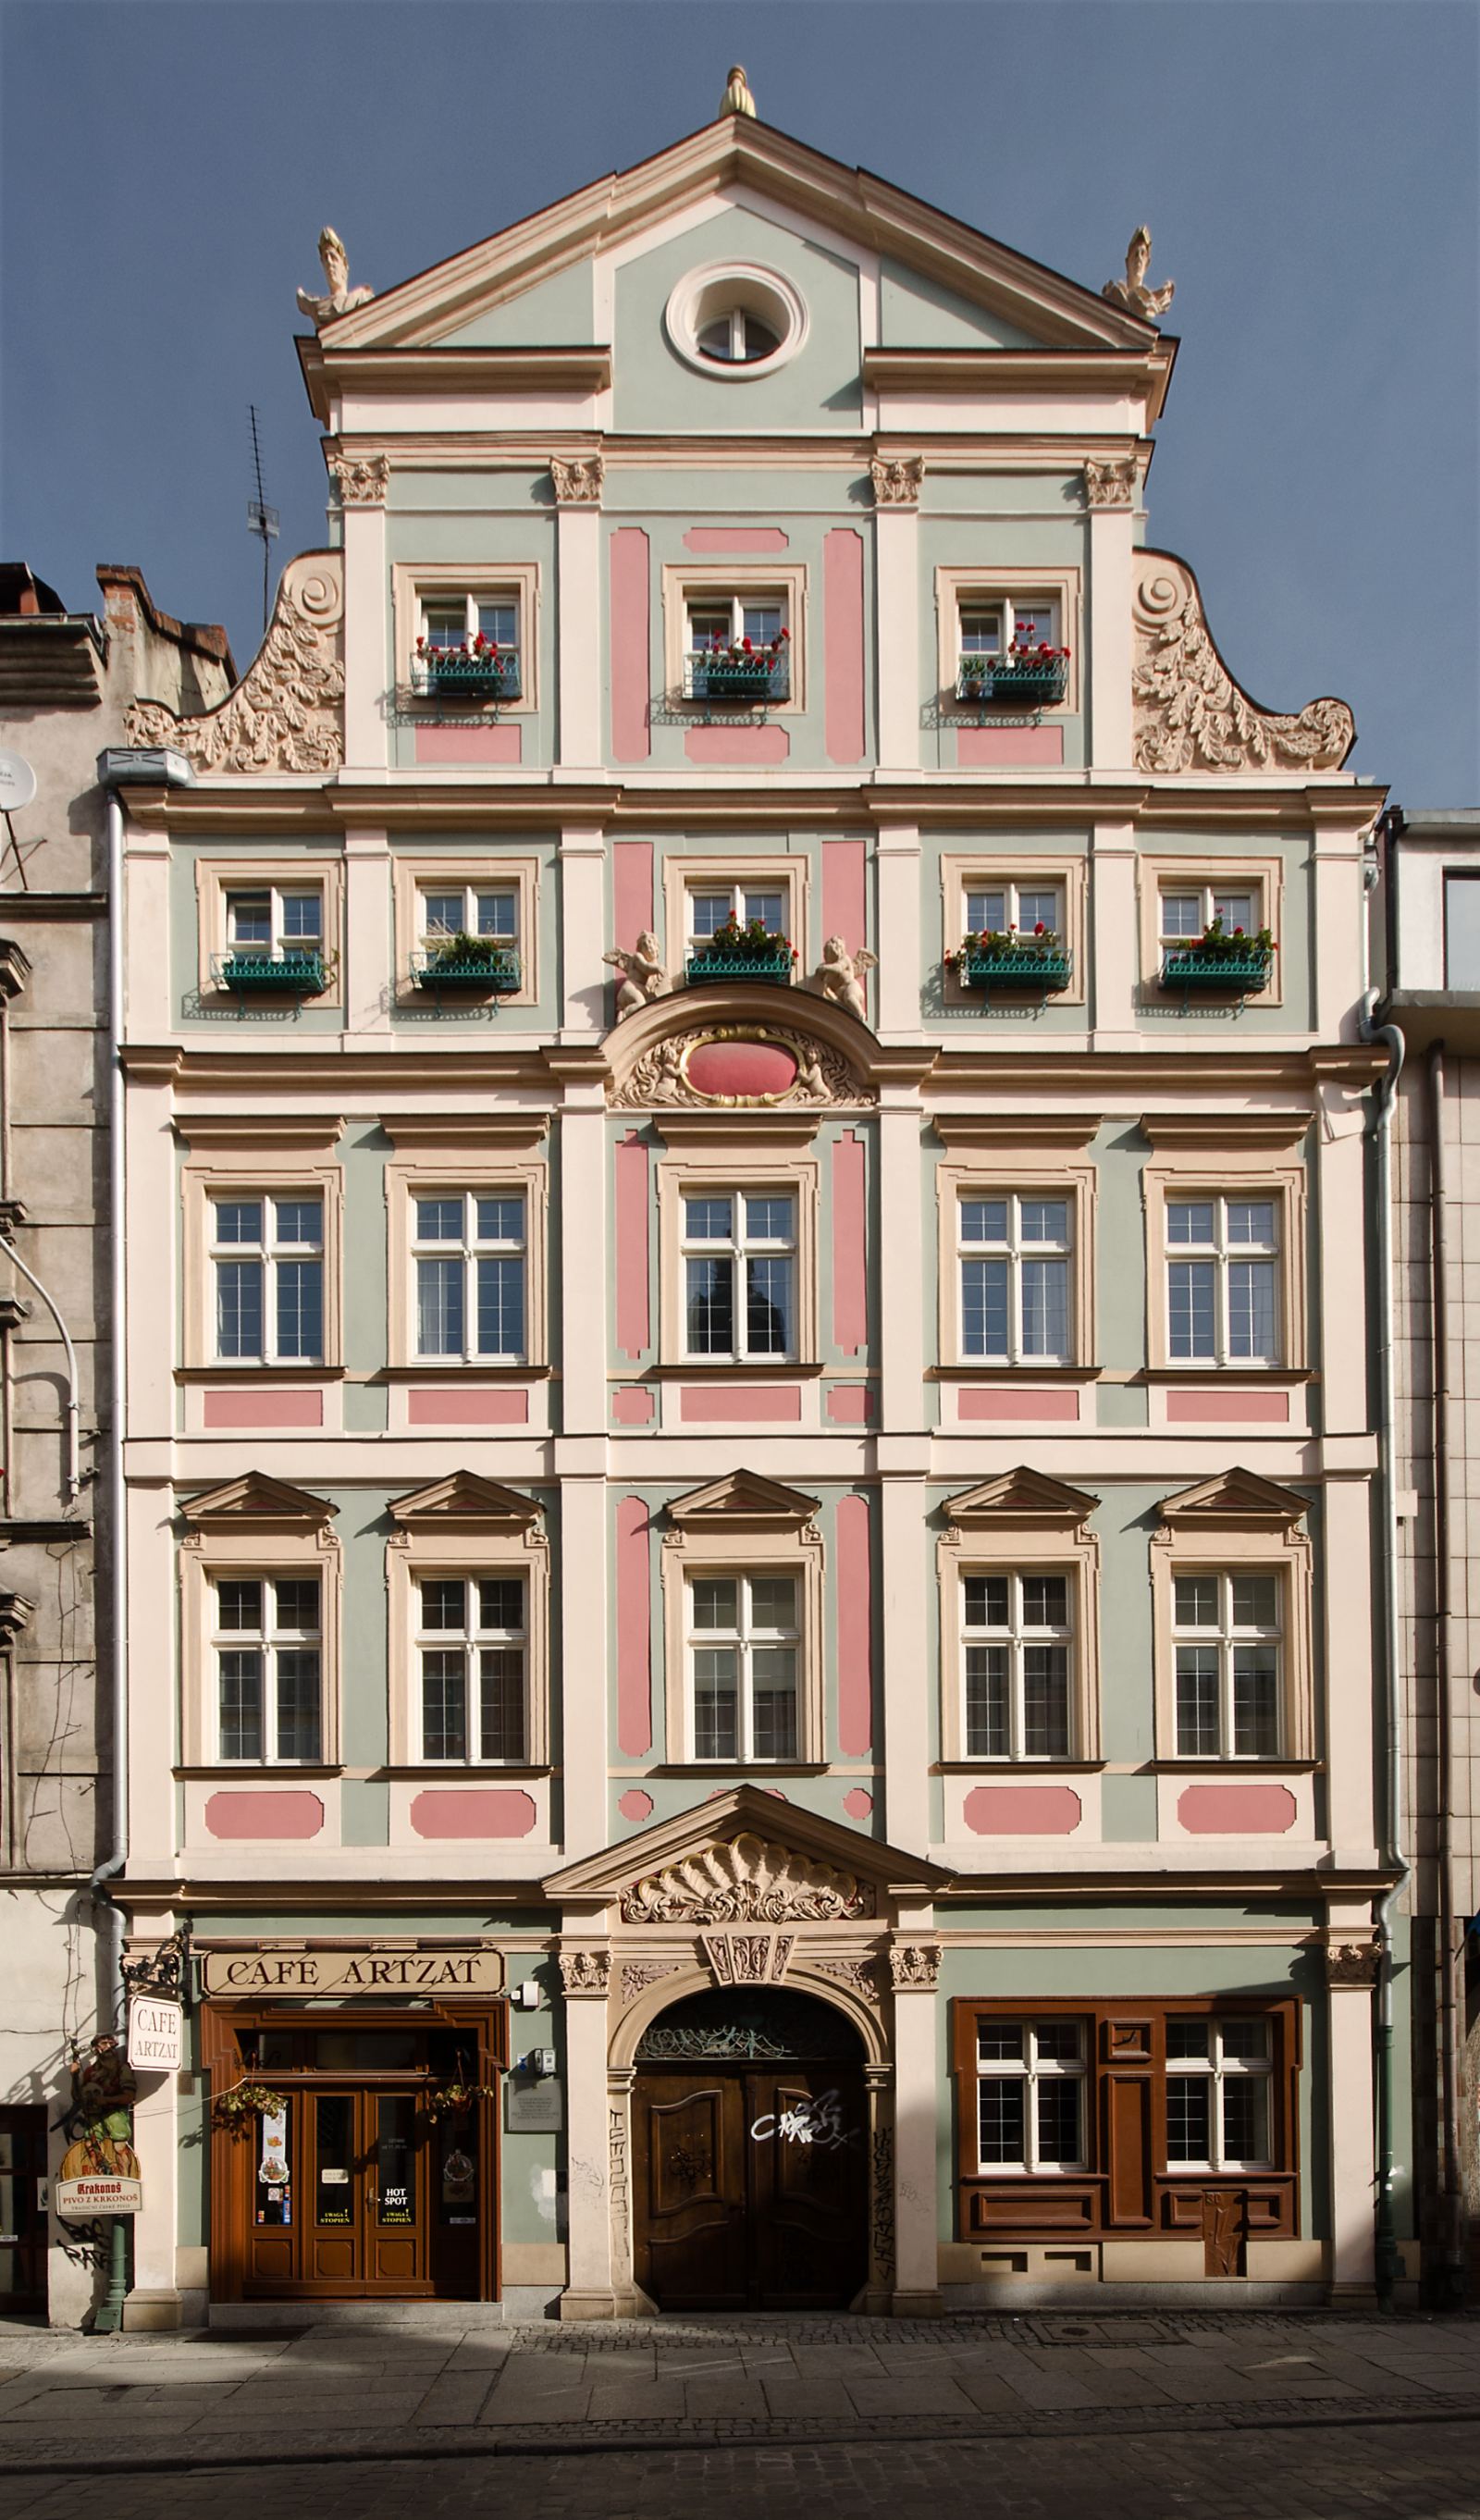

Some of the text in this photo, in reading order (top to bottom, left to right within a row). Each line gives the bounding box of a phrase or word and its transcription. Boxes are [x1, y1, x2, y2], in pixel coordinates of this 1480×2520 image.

[227, 1959, 482, 1985] CAFE ARTZAT
[138, 2008, 177, 2034] CAFE
[135, 2041, 178, 2058] ARTZAT
[77, 2181, 122, 2195] Krakonoš
[386, 2188, 406, 2196] HOT
[93, 2193, 138, 2203] KRKONOŠ
[384, 2197, 407, 2205] SPOT
